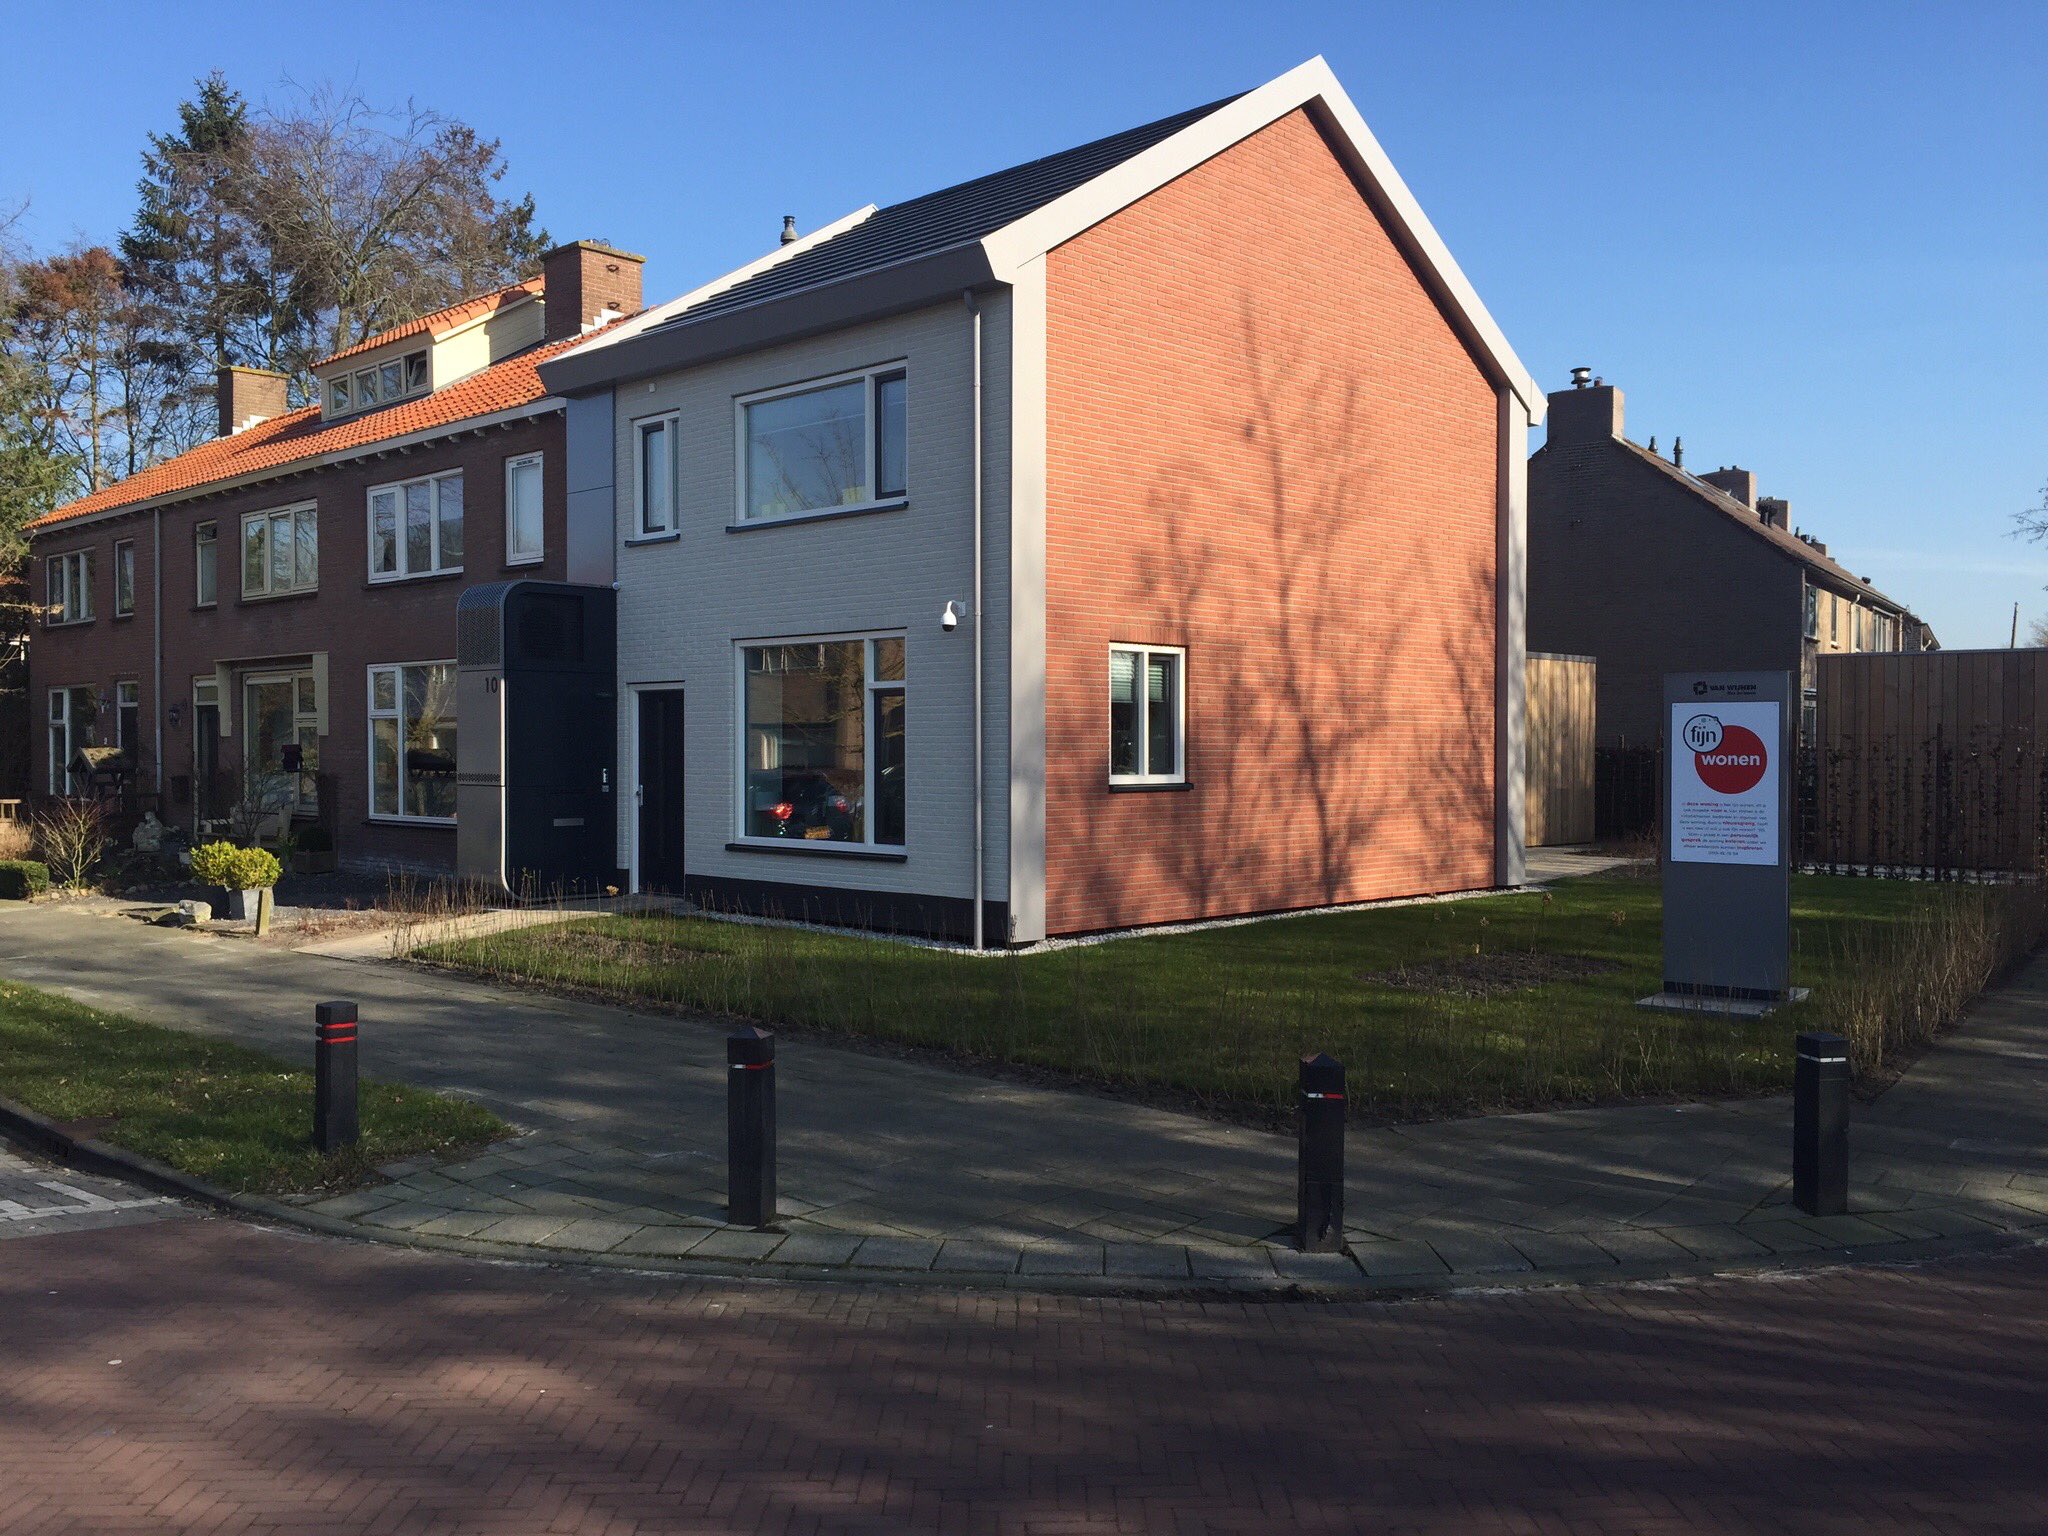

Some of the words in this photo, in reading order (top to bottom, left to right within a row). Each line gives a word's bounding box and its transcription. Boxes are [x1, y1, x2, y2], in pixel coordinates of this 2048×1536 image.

[485, 676, 498, 693] 10
[1691, 725, 1716, 746] fijn
[1701, 754, 1760, 766] wonen
